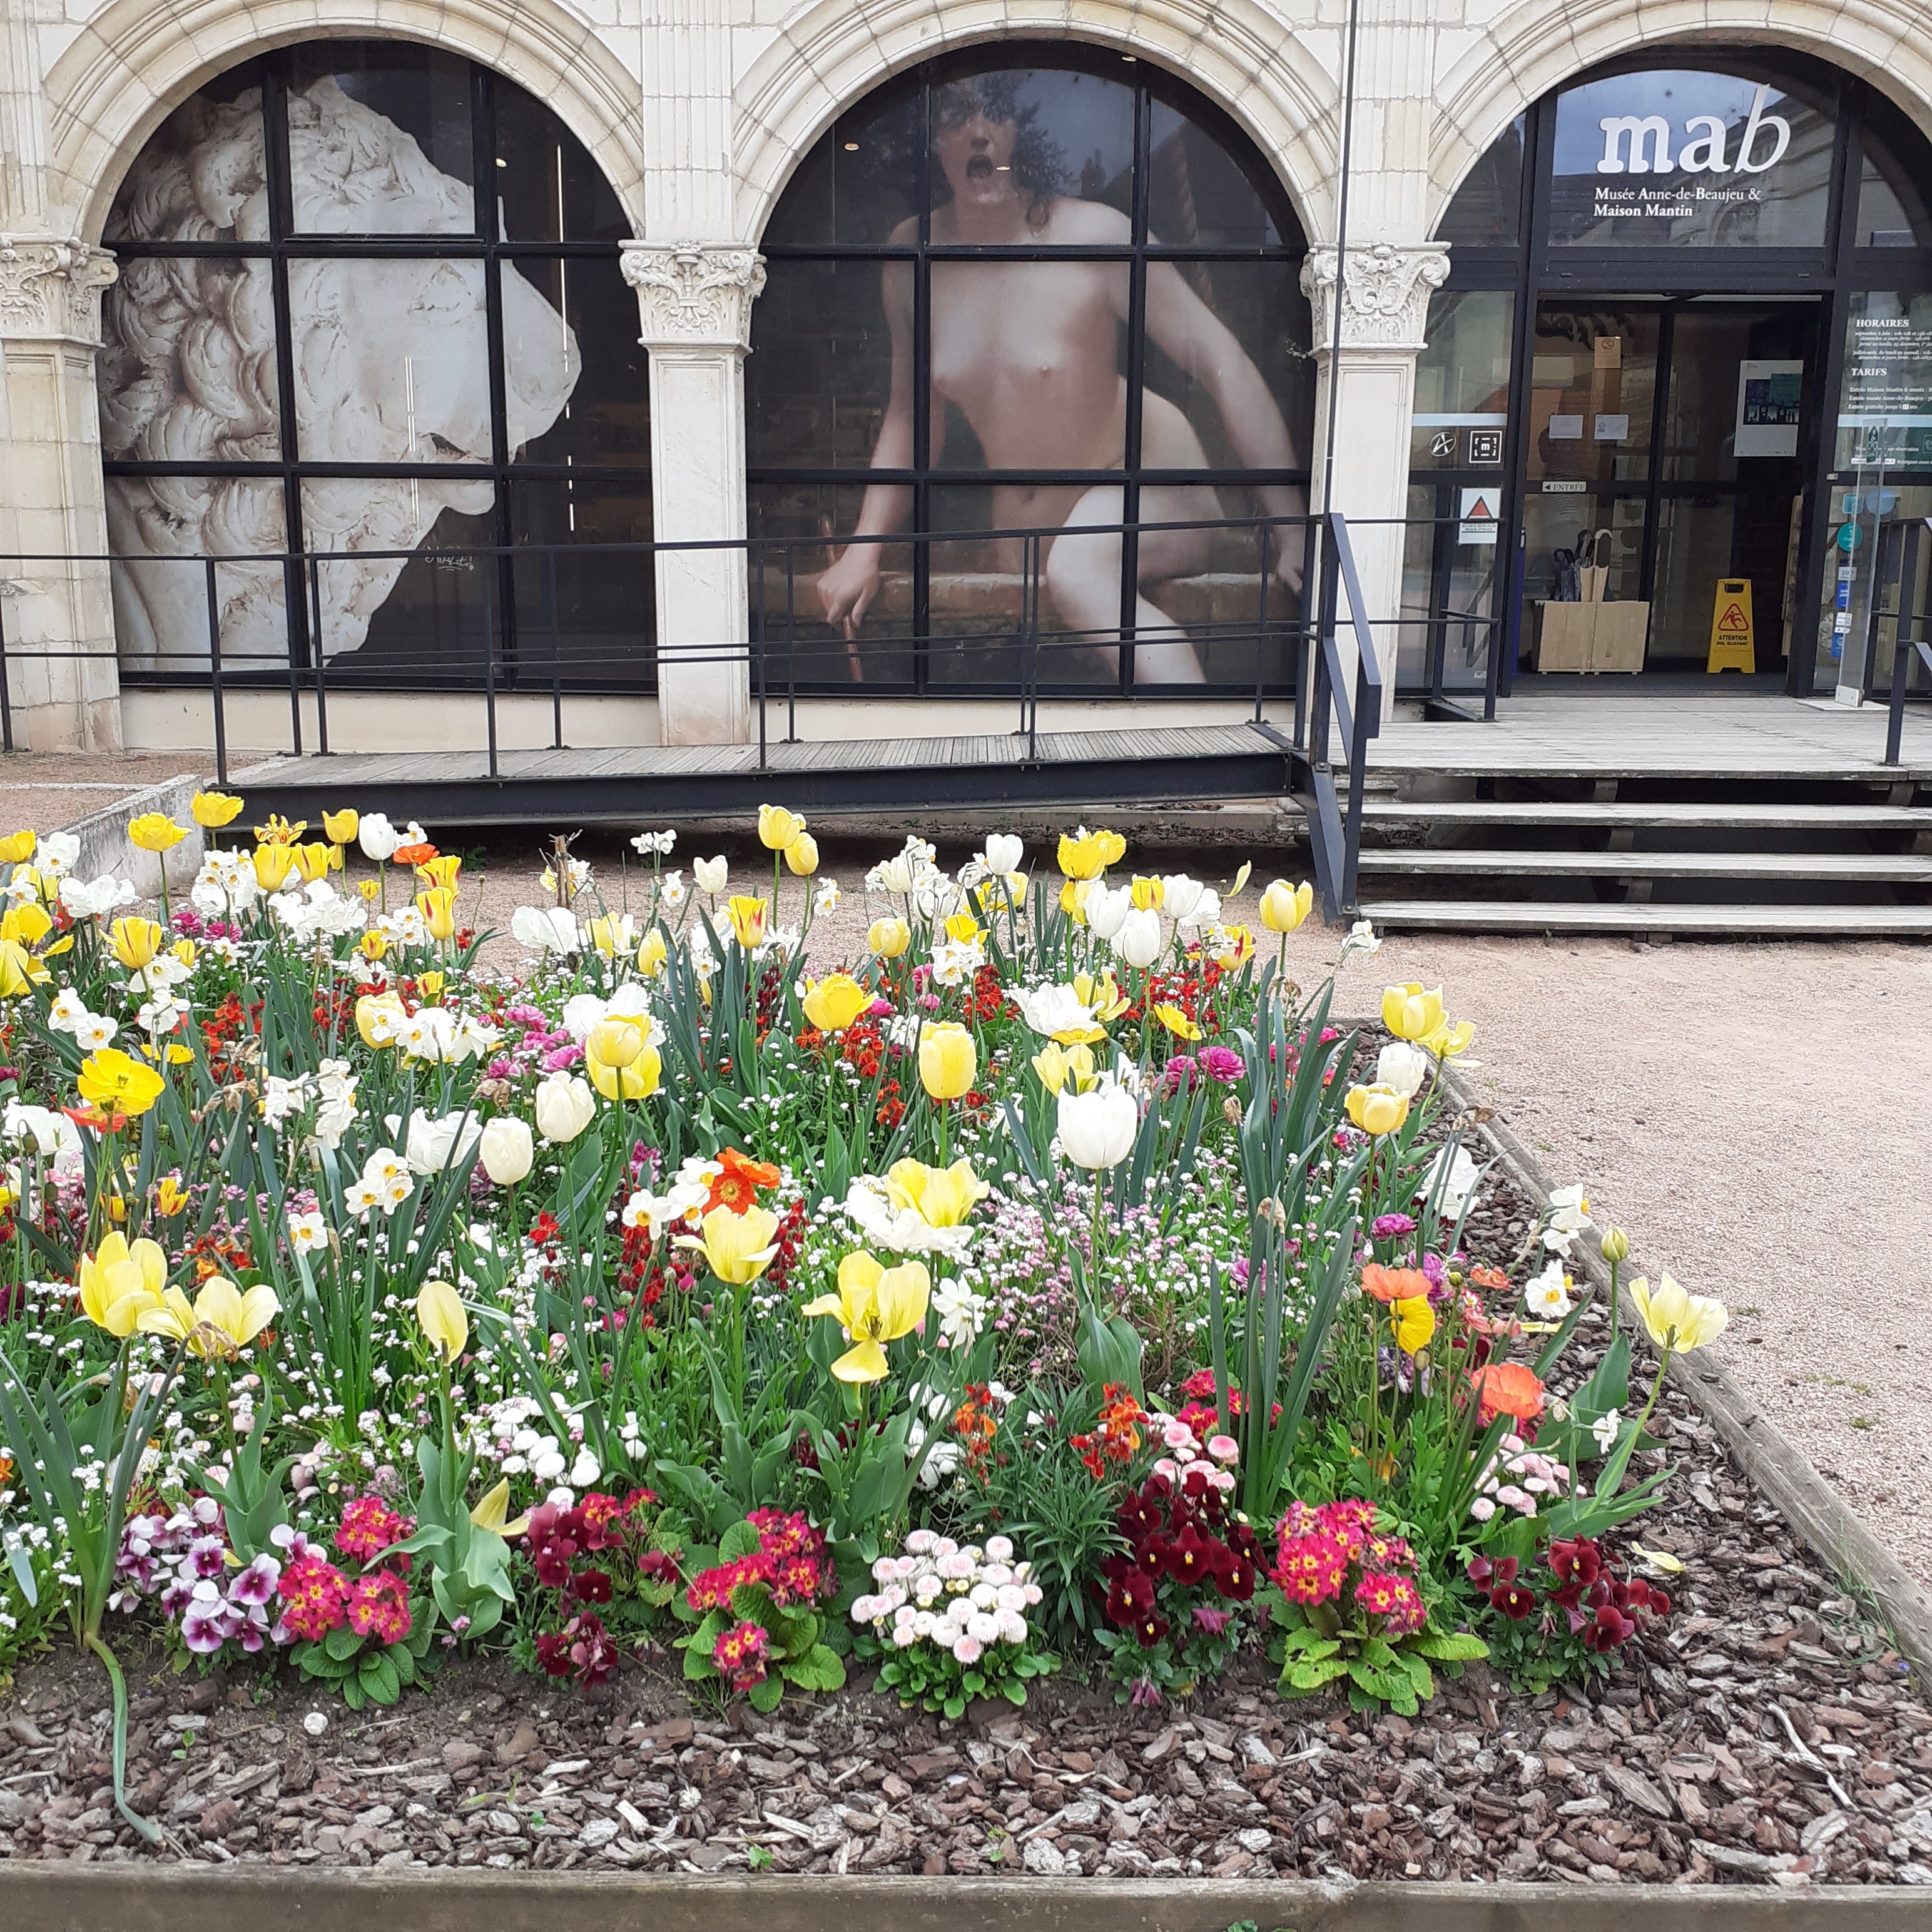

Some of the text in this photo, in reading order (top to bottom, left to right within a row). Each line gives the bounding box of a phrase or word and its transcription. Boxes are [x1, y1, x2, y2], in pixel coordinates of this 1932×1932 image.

[1596, 83, 1791, 173] mab
[1595, 187, 1762, 203] Musée Anne-de-Beaujeu &
[1594, 204, 1693, 216] Maison Mantin
[1856, 319, 1909, 327] HORAIRES
[1851, 368, 1887, 376] TARIFS
[1553, 482, 1586, 491] ENTRÉE
